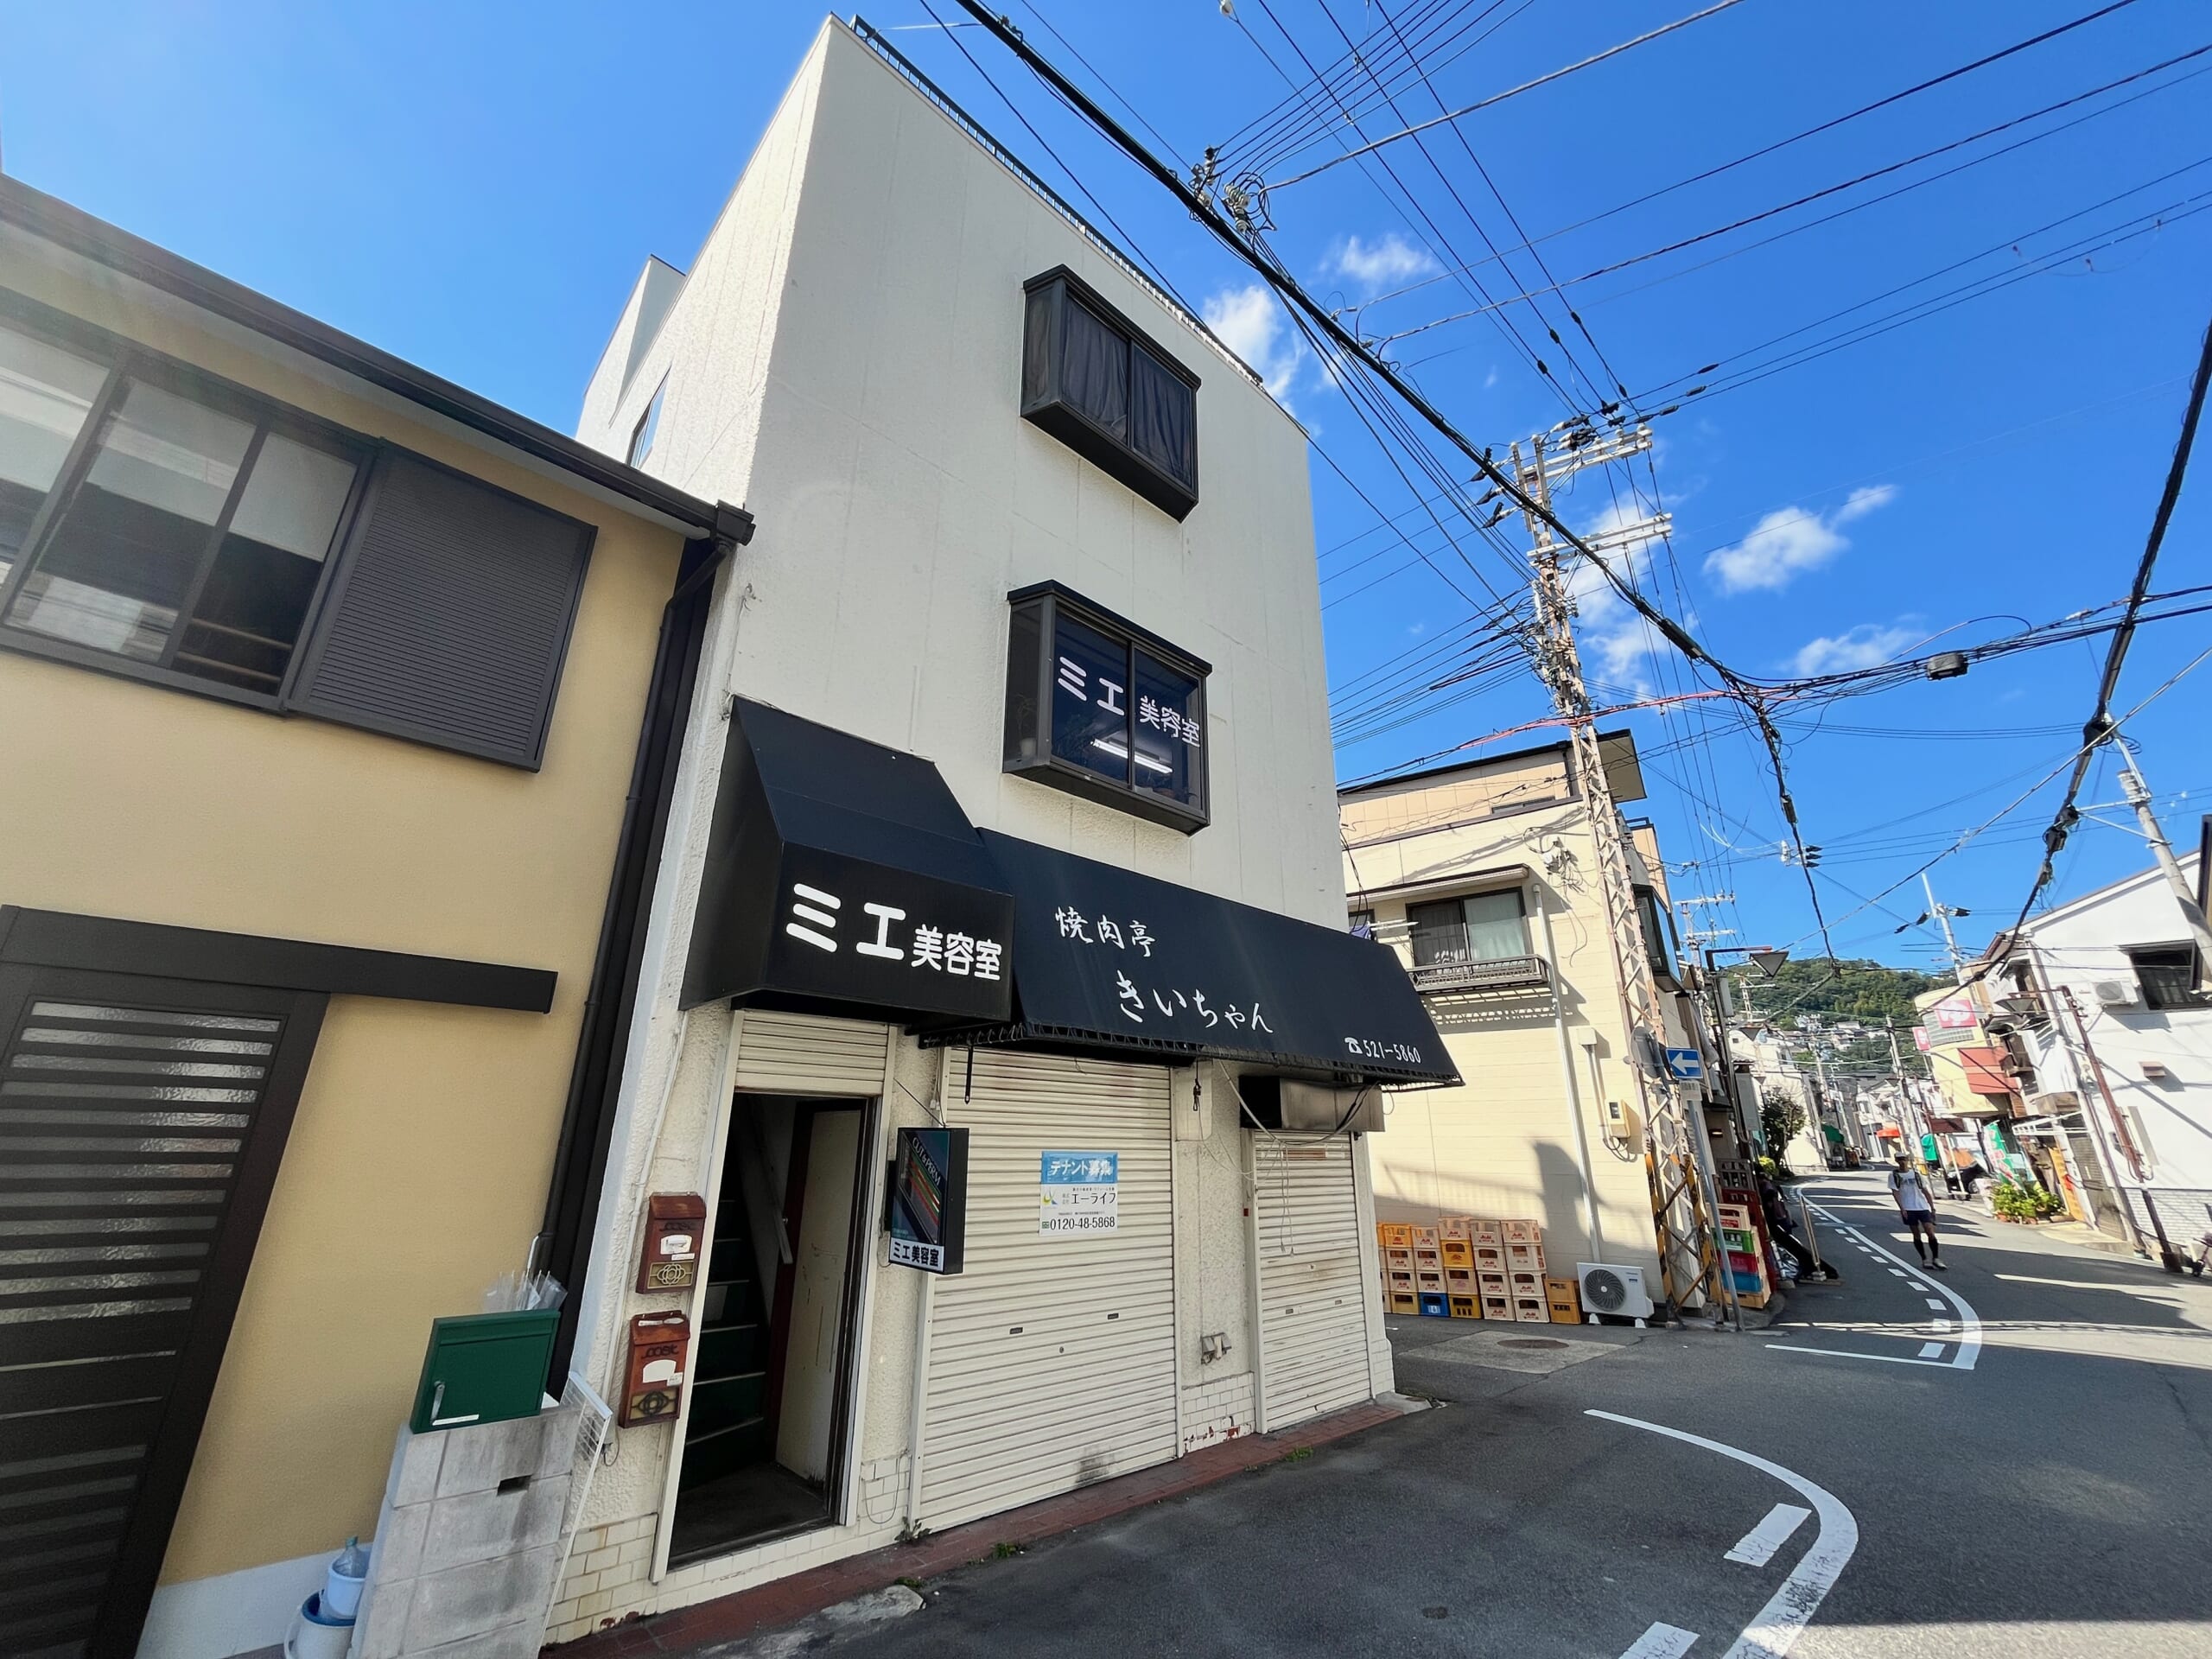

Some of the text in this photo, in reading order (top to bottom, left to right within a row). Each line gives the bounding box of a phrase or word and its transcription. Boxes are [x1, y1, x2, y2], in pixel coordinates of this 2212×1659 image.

[1054, 906, 1155, 957] 焼肉亭
[1116, 969, 1274, 1033] きいちゃん
[1363, 1039, 1421, 1064] 521-5860
[1050, 1160, 1113, 1176] テナント募集
[1071, 1192, 1116, 1205] エーライフ
[1050, 1216, 1116, 1230] 0120-48-5868
